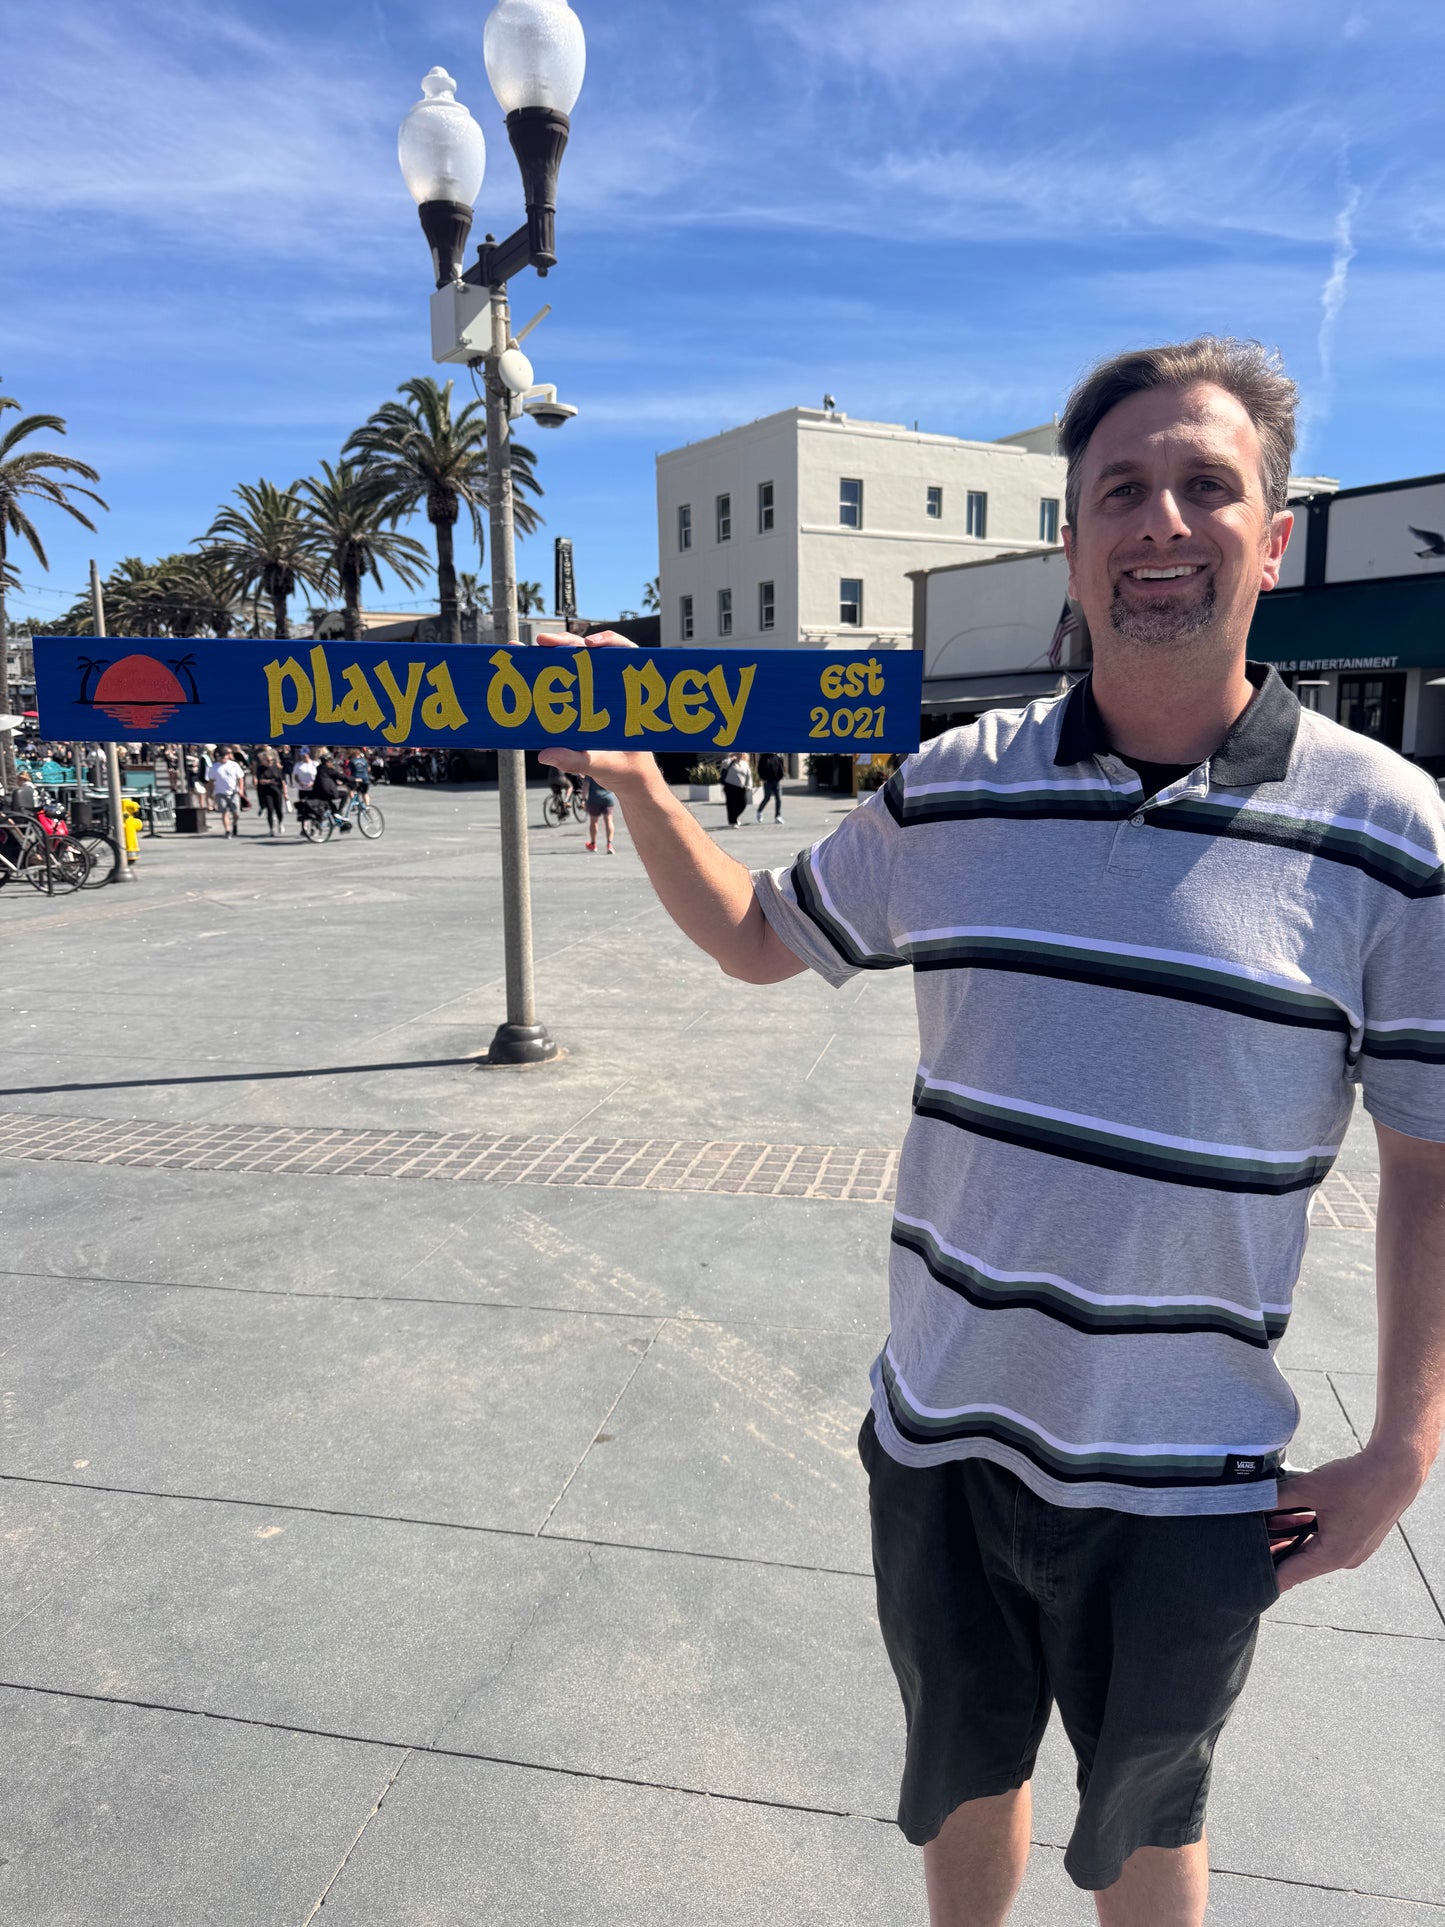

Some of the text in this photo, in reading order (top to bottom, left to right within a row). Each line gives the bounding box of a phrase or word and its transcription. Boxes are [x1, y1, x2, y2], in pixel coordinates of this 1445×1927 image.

[1300, 657, 1398, 671] ENTERTAINMENT
[808, 707, 886, 739] 2021
[1236, 1461, 1255, 1469] VANS
